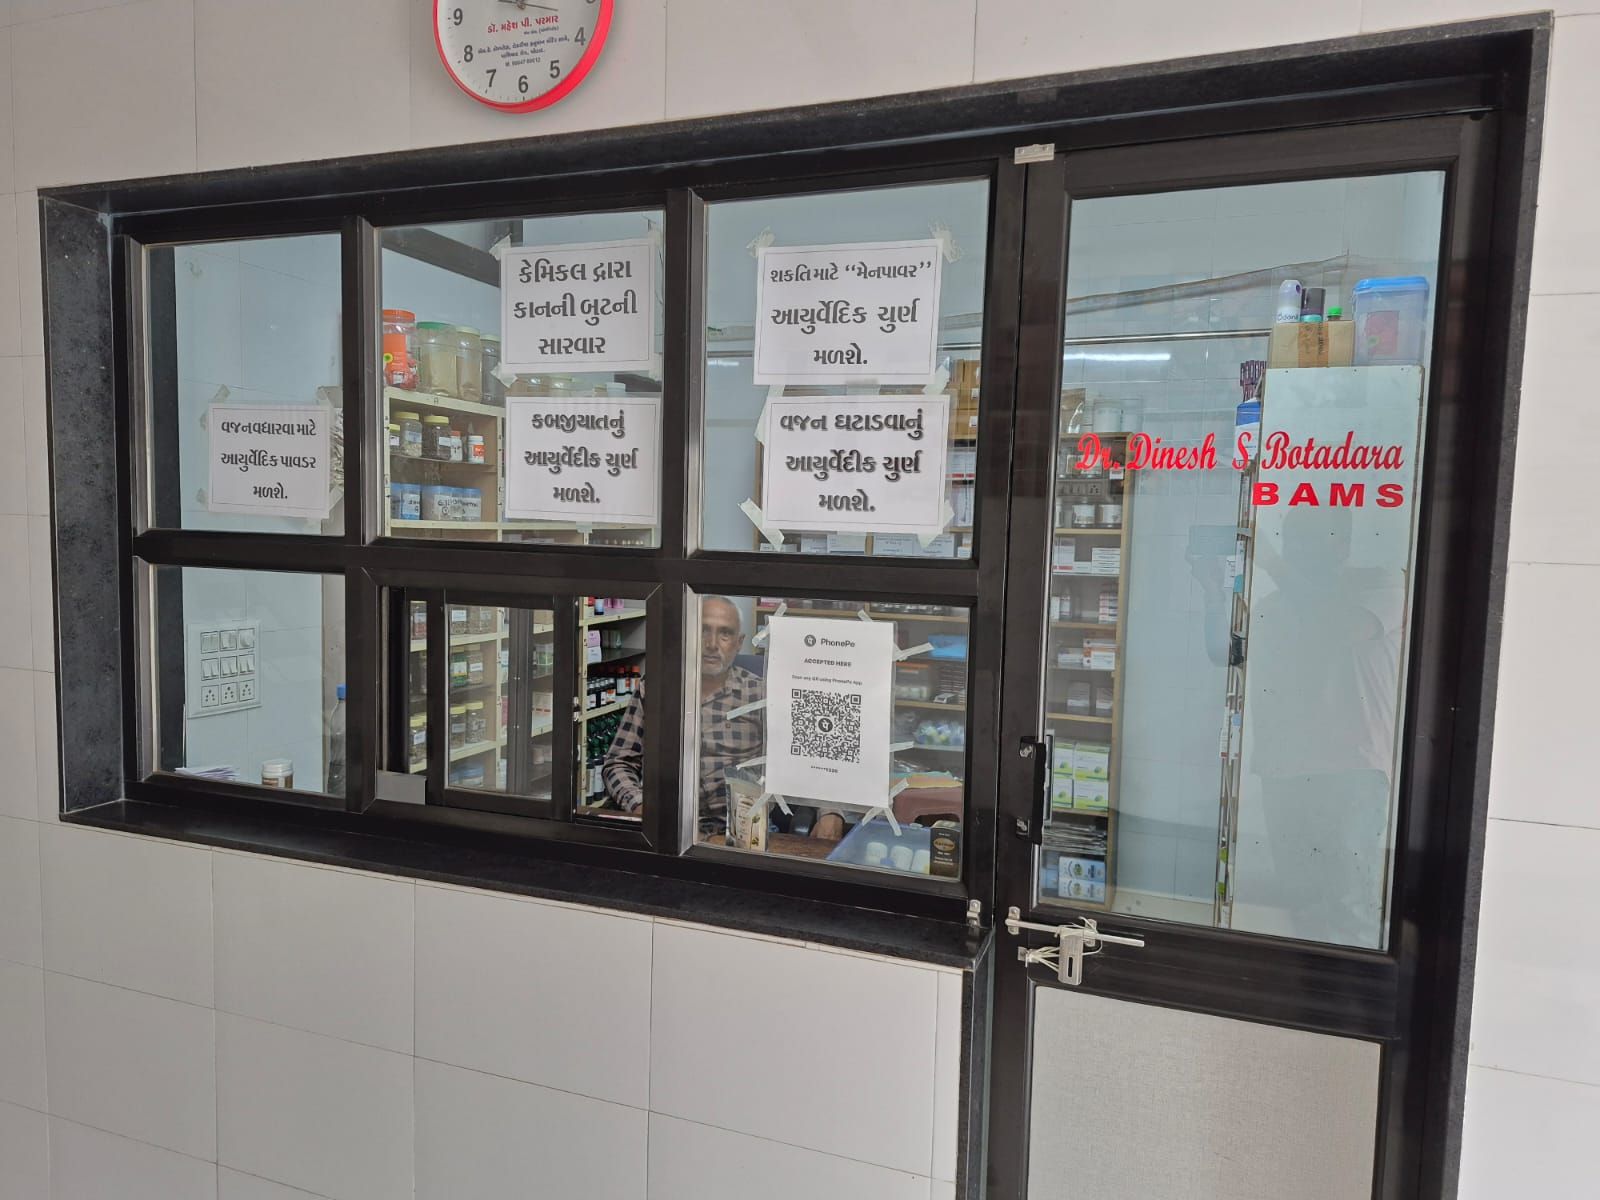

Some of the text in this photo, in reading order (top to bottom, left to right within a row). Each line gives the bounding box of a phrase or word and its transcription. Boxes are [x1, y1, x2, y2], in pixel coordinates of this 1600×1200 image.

[453, 8, 463, 26] 9
[574, 27, 586, 46] 4
[463, 45, 473, 62] 8
[486, 69, 497, 87] 7
[550, 60, 560, 79] 5
[518, 75, 528, 93] 6
[519, 258, 632, 284] કેમિકલ દ્વારા
[813, 262, 839, 281] માટે
[513, 289, 638, 326] કાનની બુટની
[771, 298, 920, 335] આયુર્વેદિક ચુર્ણ
[538, 337, 606, 355] સારવાર
[813, 342, 868, 365] મળશે.
[779, 414, 827, 432] વજન
[1076, 433, 1121, 471] Dr.
[1126, 432, 1217, 471] Dinesh
[1261, 431, 1403, 470] Botadara
[220, 449, 317, 473] આયુર્વેદિક પાવડર
[524, 445, 639, 477] આયુર્વેદીક ચુર્ણ
[785, 449, 922, 482] આયુર્વેદીક ચુર્ણ
[252, 481, 288, 500] મળશે.
[553, 482, 601, 504] મળશે.
[818, 488, 876, 513] મળશે.
[820, 638, 856, 648] PhonePe
[804, 658, 835, 666] ACCEPTED
